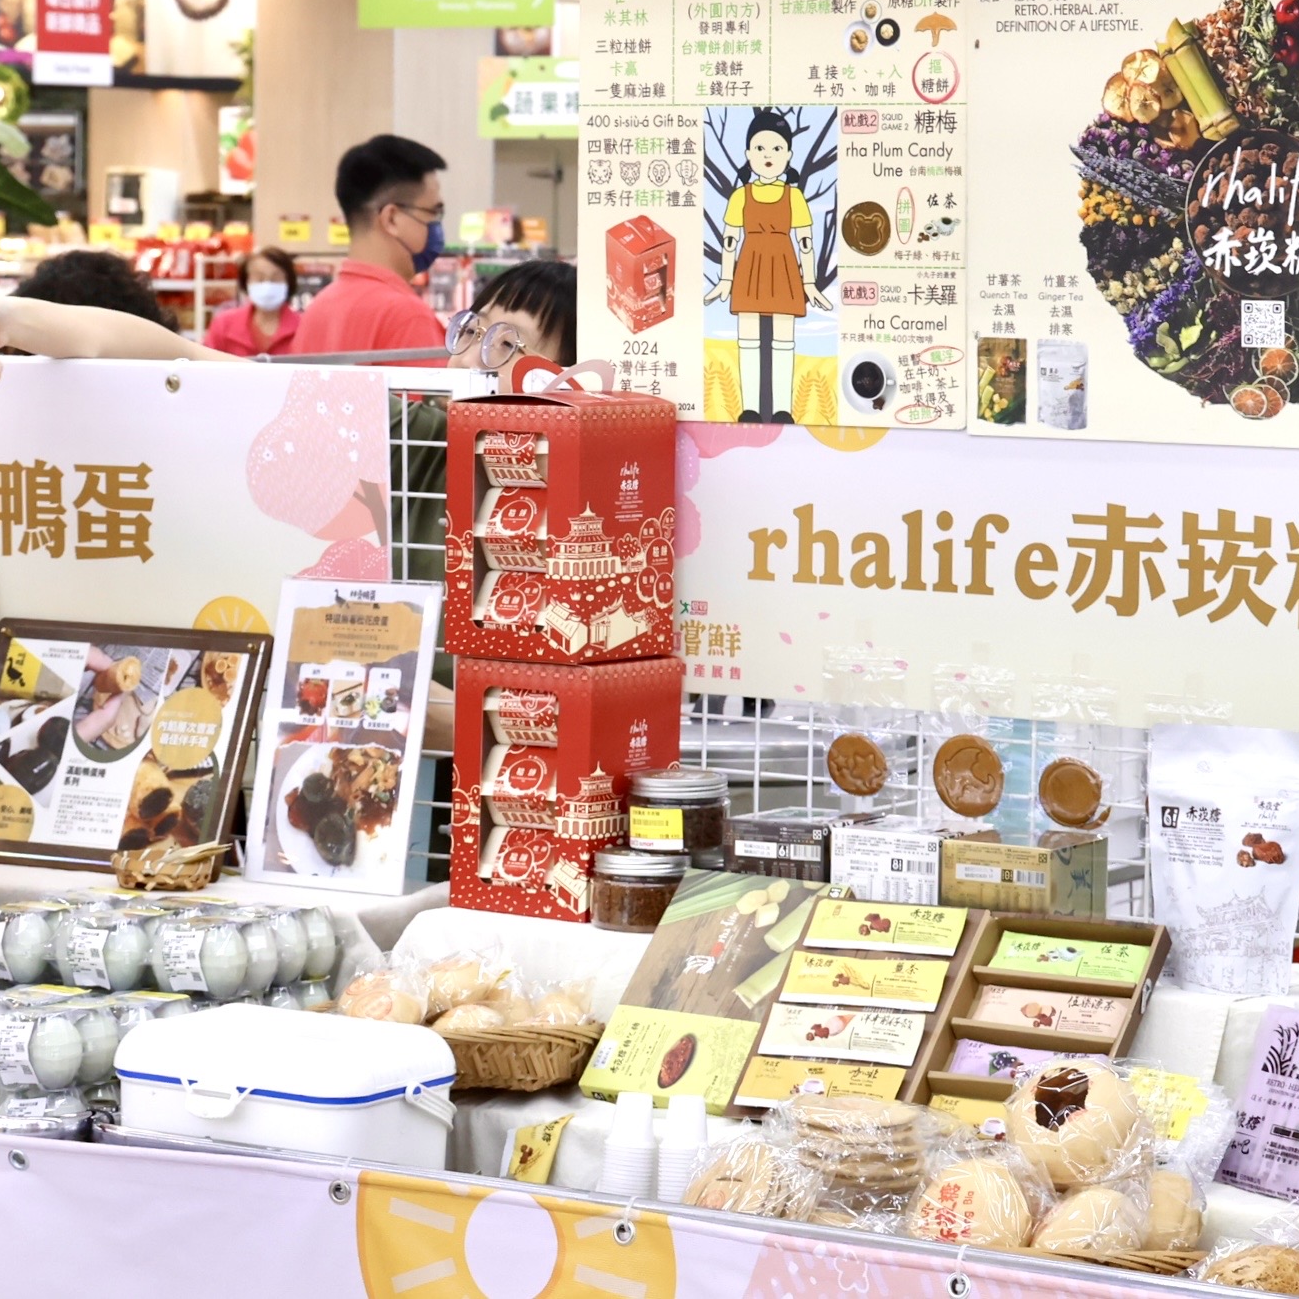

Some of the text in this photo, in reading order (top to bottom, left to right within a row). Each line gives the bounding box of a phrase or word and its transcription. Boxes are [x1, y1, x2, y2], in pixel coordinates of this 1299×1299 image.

[604, 9, 649, 27] 米其林
[996, 19, 1143, 32] DEFINITION LIFESTYLE.
[699, 20, 750, 35] 發明專利
[595, 38, 652, 54] 三粒椪餅
[700, 61, 744, 77] 吃錢餅
[595, 82, 667, 99] 一隻麻油雞
[696, 80, 754, 97] 生錢仔子
[921, 78, 950, 94] 糖餅
[586, 113, 698, 128] 400 Gift Box
[914, 109, 958, 135] 糖梅
[846, 141, 953, 161] rha Plum Candy
[872, 162, 903, 177] Ume
[907, 283, 958, 306] 卡美羅
[980, 290, 1028, 299] Quench Tea
[1038, 292, 1083, 301] Ginger Tea
[864, 314, 947, 331] rha Caramel
[622, 341, 659, 356] 2024
[619, 378, 662, 395] 第一名
